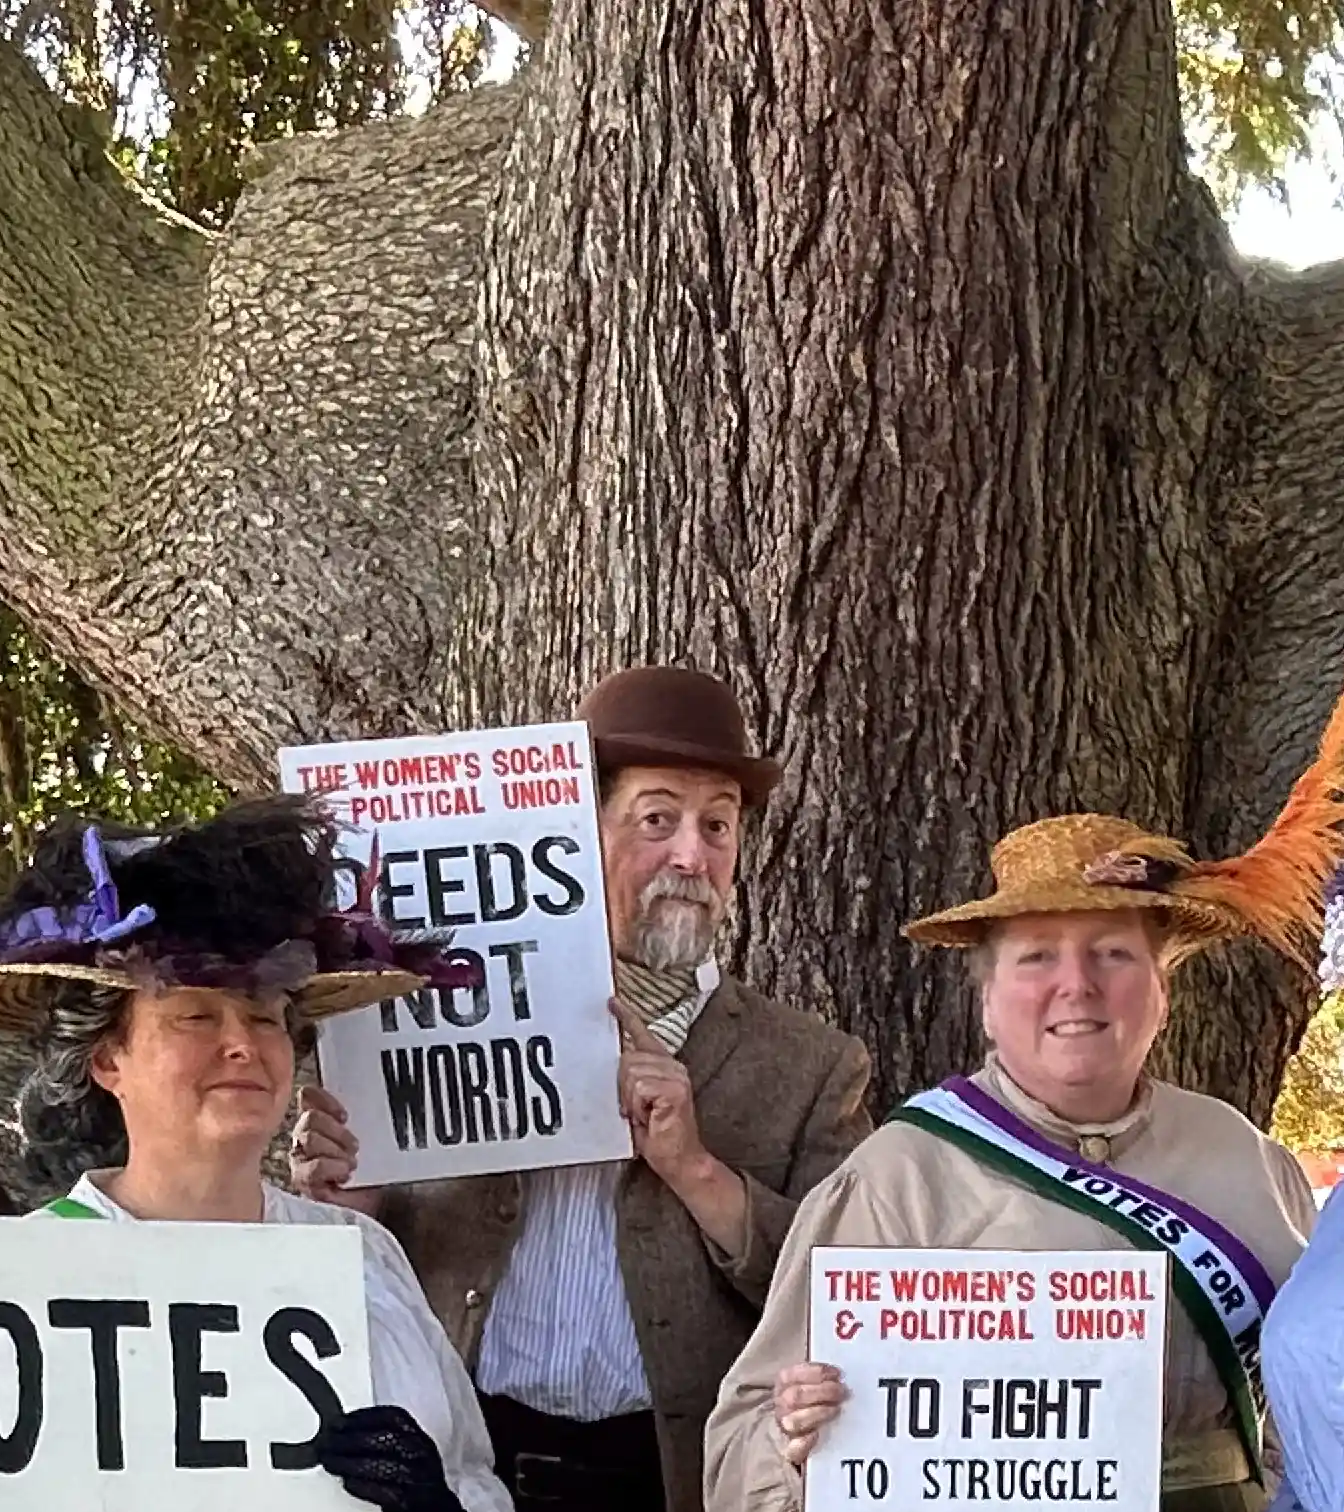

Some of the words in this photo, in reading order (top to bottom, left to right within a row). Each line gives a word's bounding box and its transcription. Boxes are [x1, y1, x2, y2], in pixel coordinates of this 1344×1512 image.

[297, 764, 349, 794] THE
[355, 754, 481, 788] WOMEN'S
[493, 742, 583, 776] SOCIAL
[350, 788, 485, 825] POLITICAL
[501, 776, 581, 809] UNION
[380, 1034, 564, 1152] WORDS
[1062, 1168, 1189, 1244] VOTES
[1193, 1250, 1246, 1315] FOR
[827, 1270, 879, 1301] THE
[891, 1270, 1035, 1302] WOMEN'S
[1049, 1270, 1155, 1302] SOCIAL
[835, 1310, 864, 1341] &
[879, 1309, 1034, 1341] POLITICAL
[1055, 1310, 1145, 1340] UNION
[878, 1378, 940, 1438] TO
[961, 1378, 1102, 1440] FIGHT
[841, 1458, 888, 1500] TO
[922, 1458, 1118, 1501] STRUGGLE
